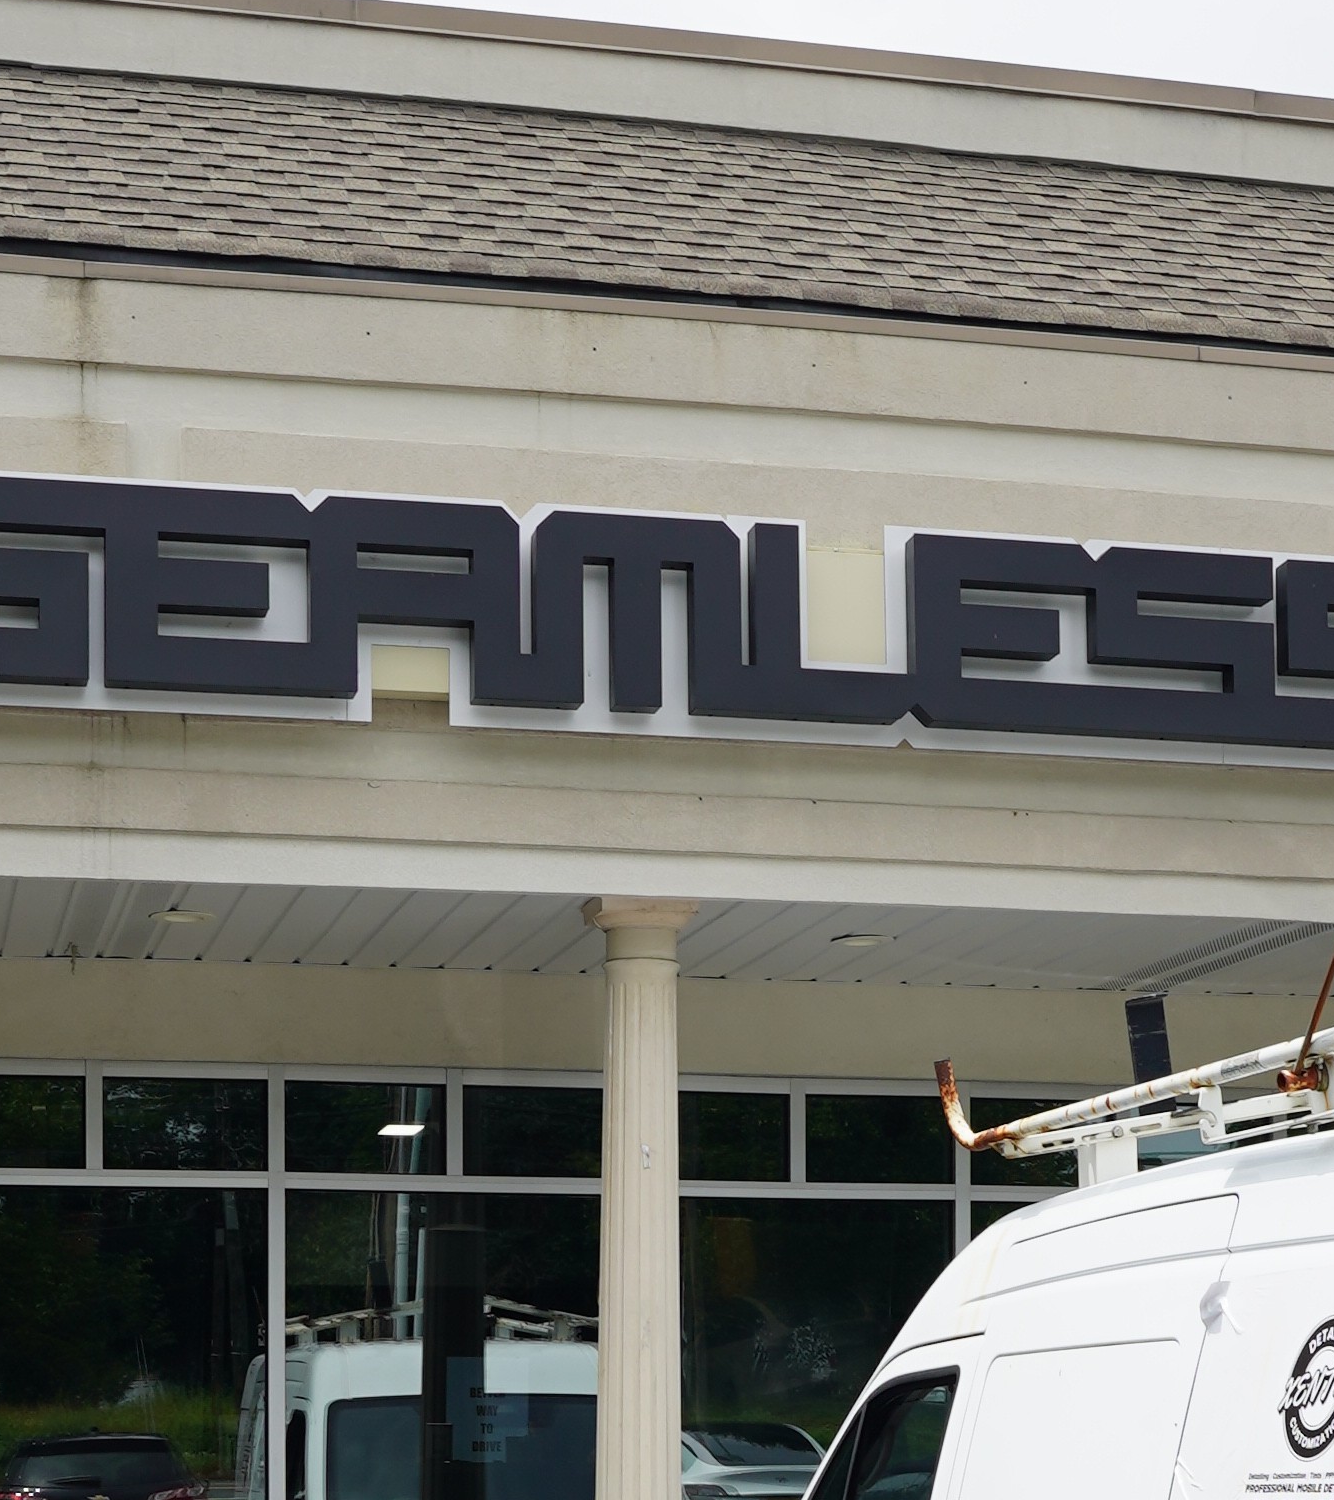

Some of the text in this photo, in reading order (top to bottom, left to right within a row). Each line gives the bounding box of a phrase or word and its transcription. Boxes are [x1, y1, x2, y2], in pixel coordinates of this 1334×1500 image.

[476, 1405, 498, 1417] WAY
[480, 1423, 493, 1434] TO
[472, 1440, 502, 1452] DRIVE
[1245, 1483, 1295, 1493] PROFESSIONAL
[1296, 1483, 1323, 1493] MOBILE
